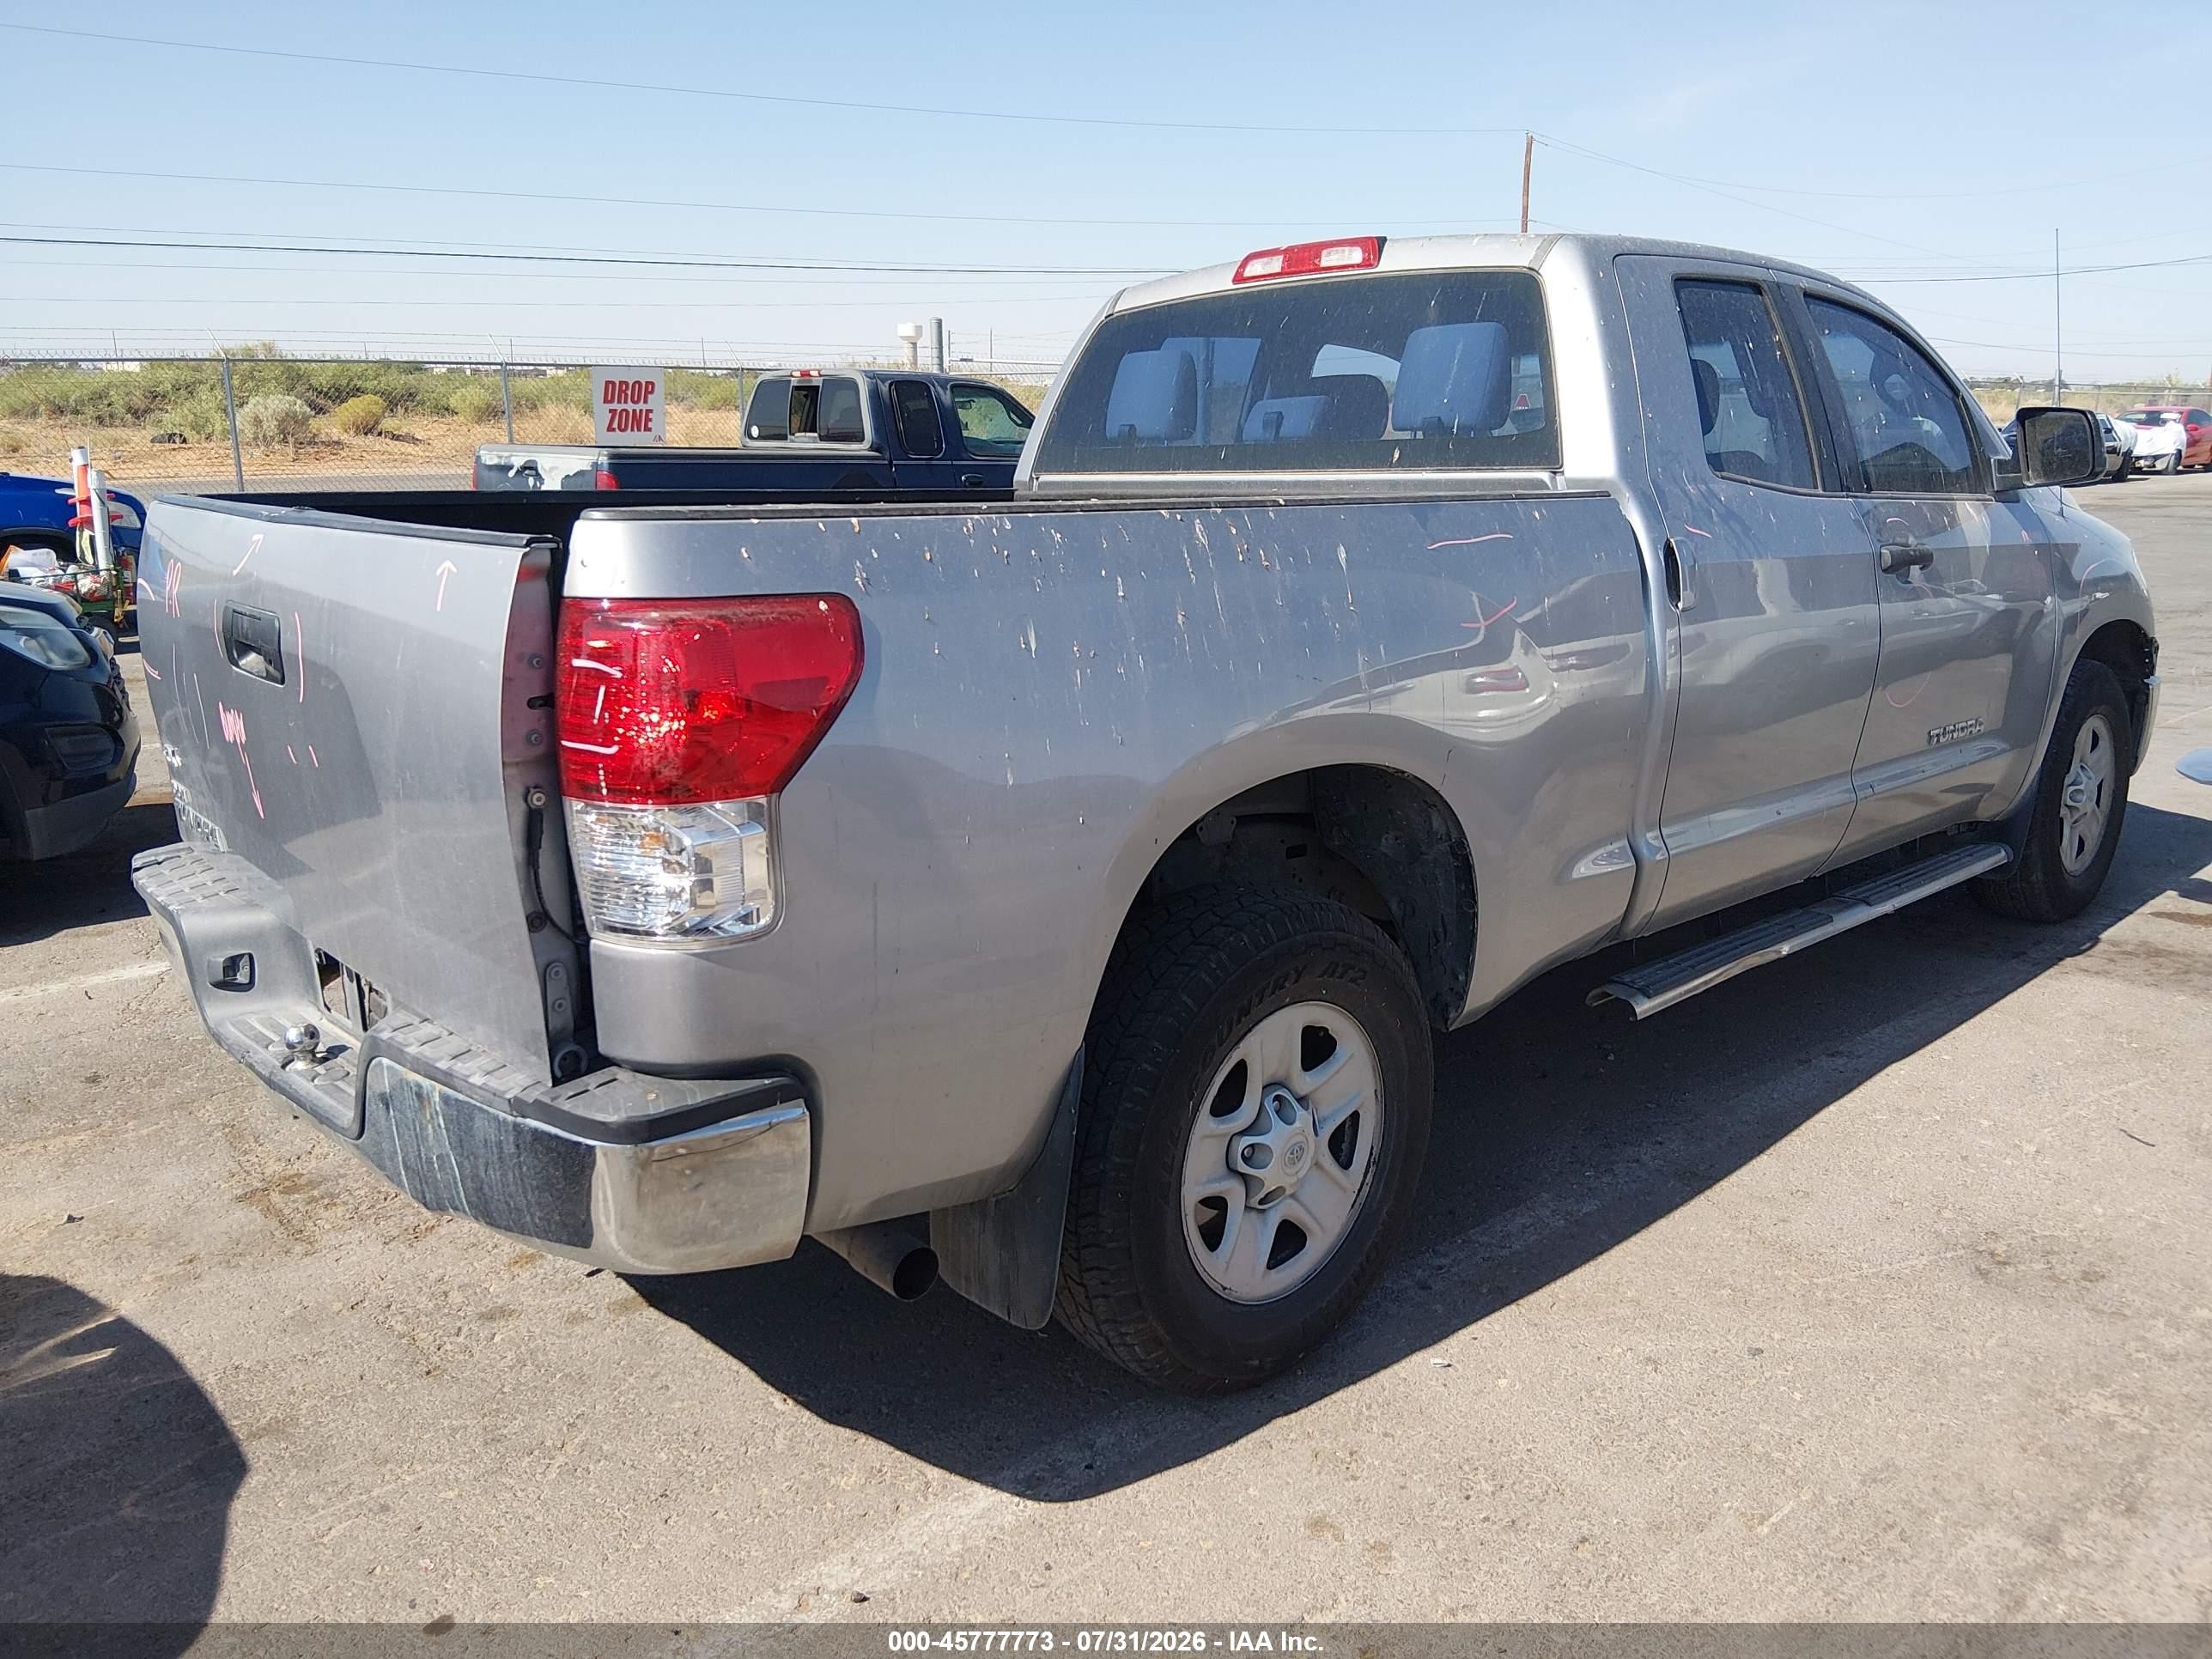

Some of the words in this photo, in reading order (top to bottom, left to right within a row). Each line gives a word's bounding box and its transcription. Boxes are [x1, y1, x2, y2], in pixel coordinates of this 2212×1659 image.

[603, 380, 655, 404] DROP
[606, 409, 653, 432] ZONE
[1929, 716, 1984, 748] TUNDRA
